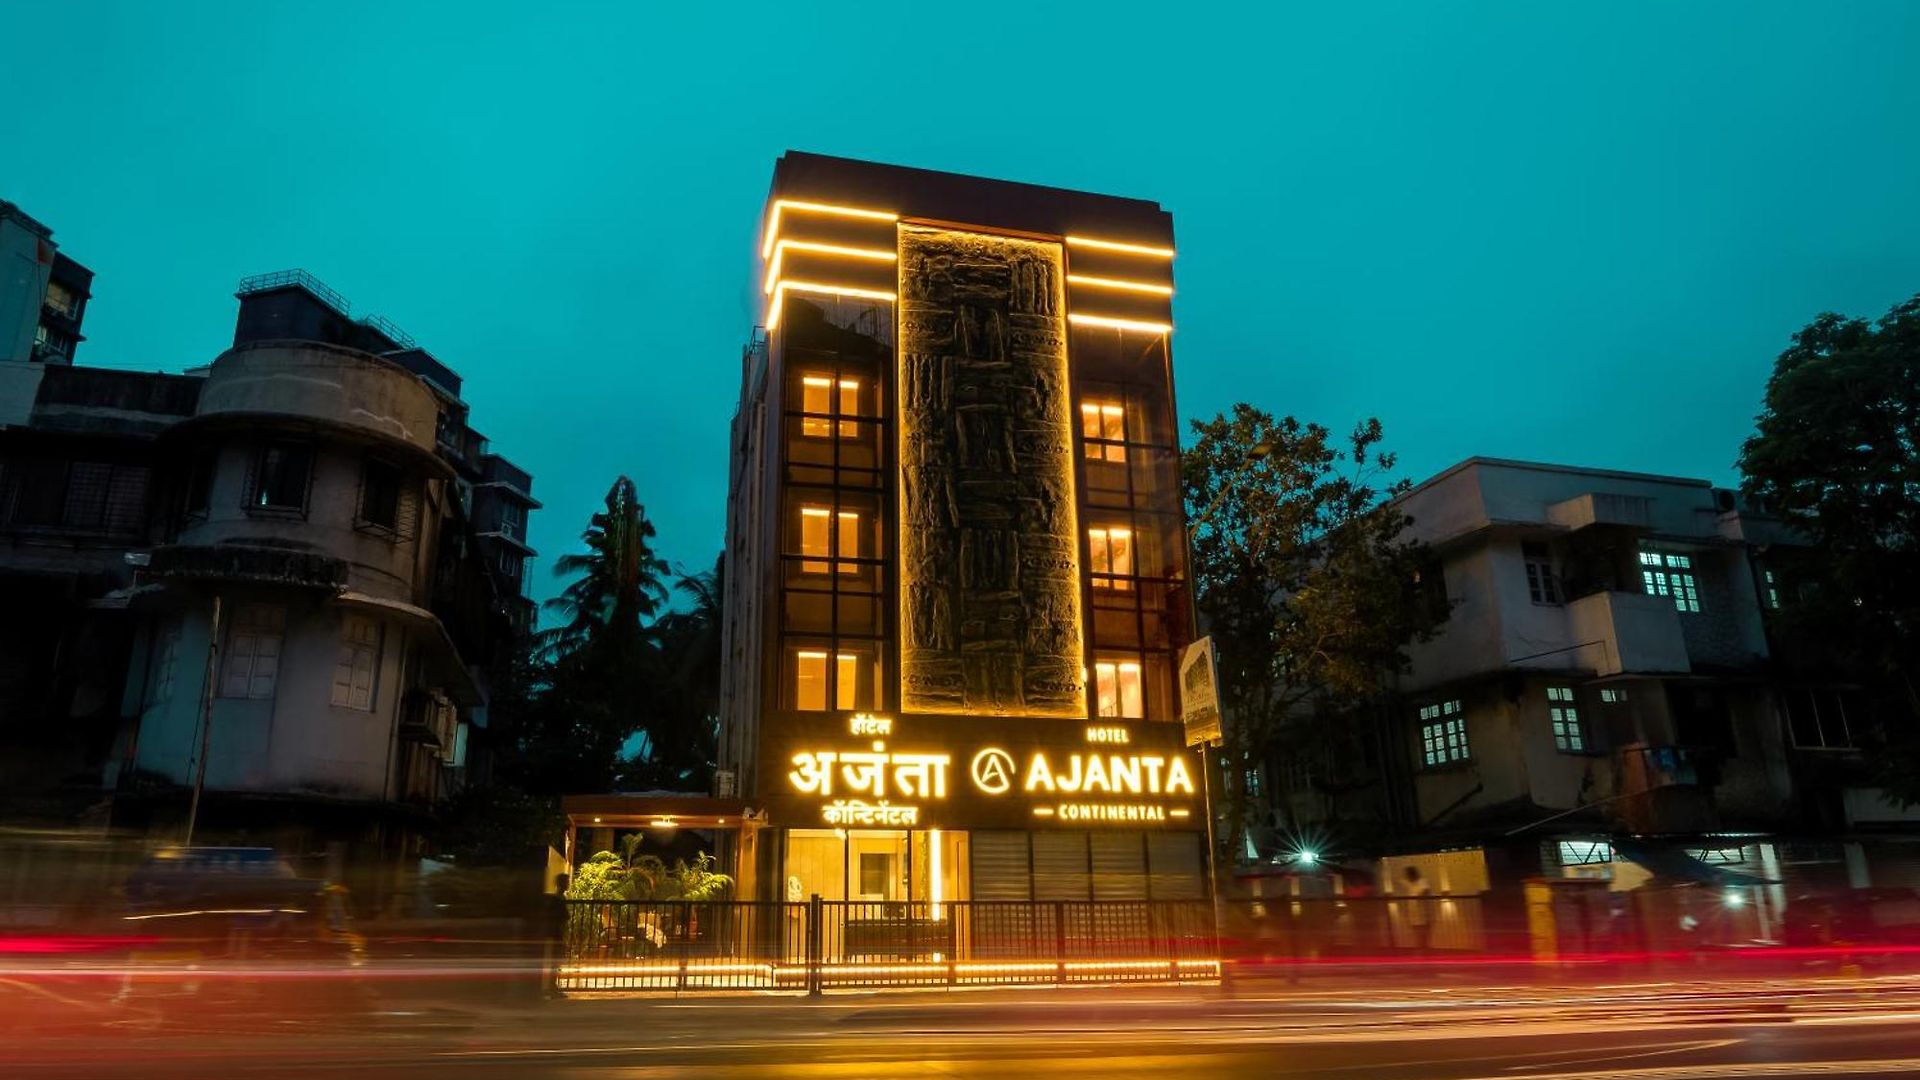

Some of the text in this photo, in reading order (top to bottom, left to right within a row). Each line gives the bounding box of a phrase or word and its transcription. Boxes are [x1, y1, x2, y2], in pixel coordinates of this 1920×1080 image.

[1086, 727, 1129, 743] HOTEL
[788, 741, 951, 798] अजंता
[1024, 752, 1195, 794] AJANTA
[1058, 804, 1166, 820] CONTINENTAL
